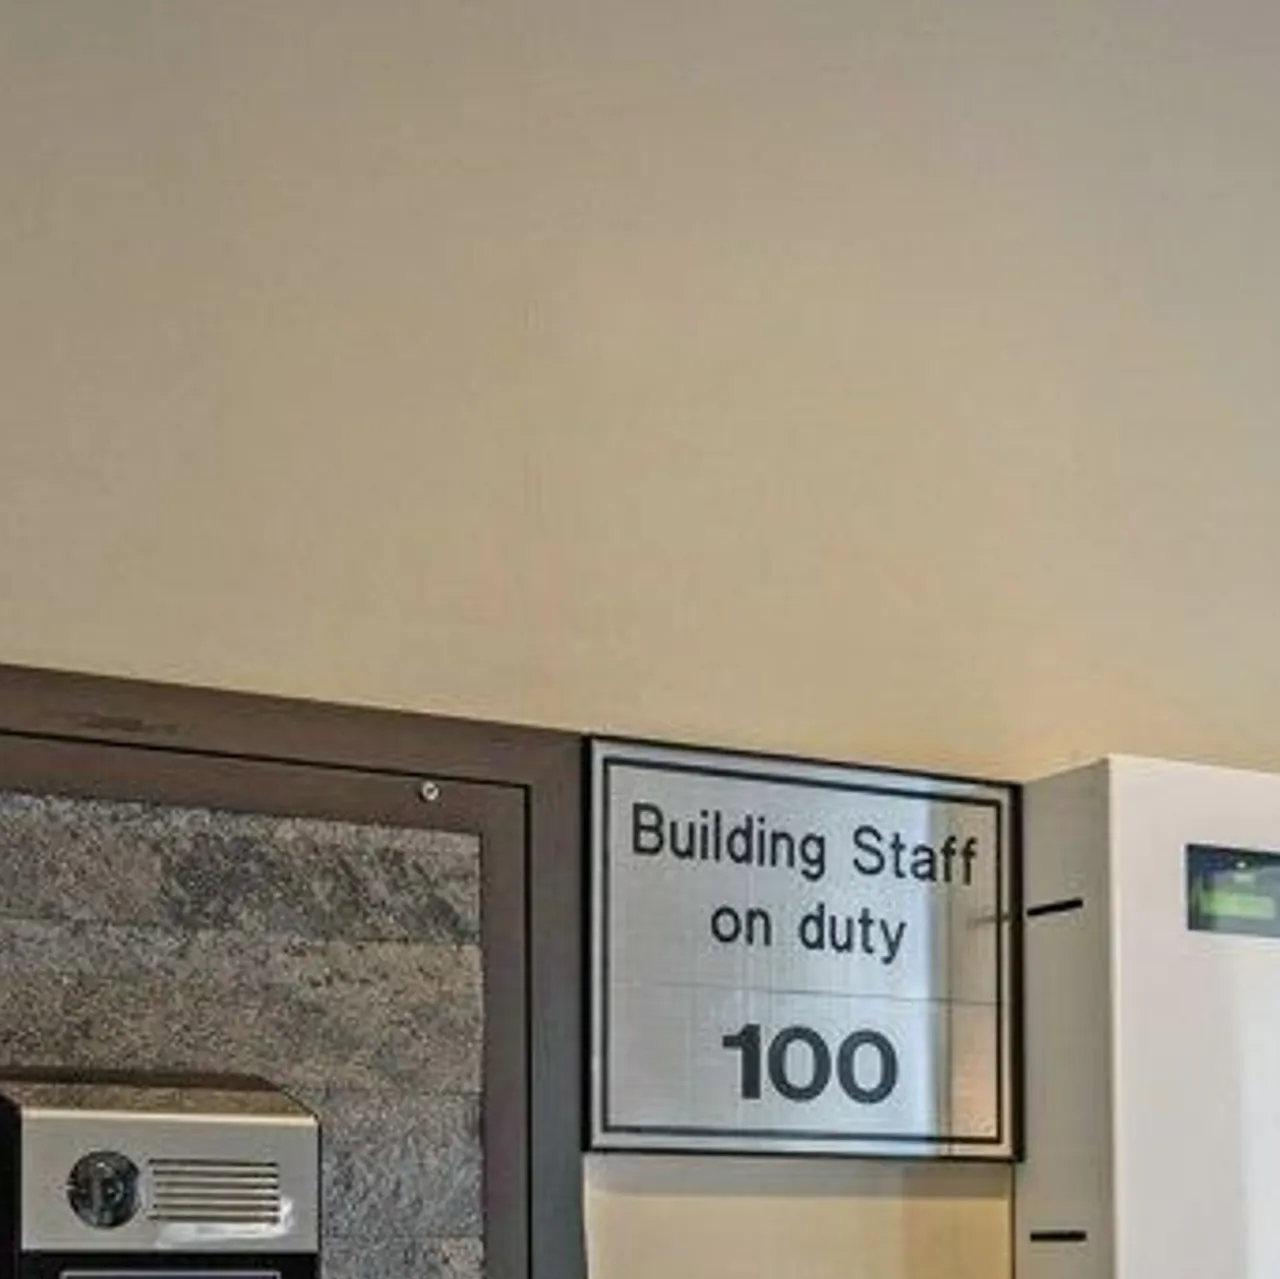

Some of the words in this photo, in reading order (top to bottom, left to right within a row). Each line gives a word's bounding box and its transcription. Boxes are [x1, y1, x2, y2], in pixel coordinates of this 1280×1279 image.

[632, 802, 826, 881] Building
[853, 825, 978, 886] Staff
[711, 907, 771, 947] on
[799, 904, 906, 965] duty
[722, 1024, 898, 1105] 100
